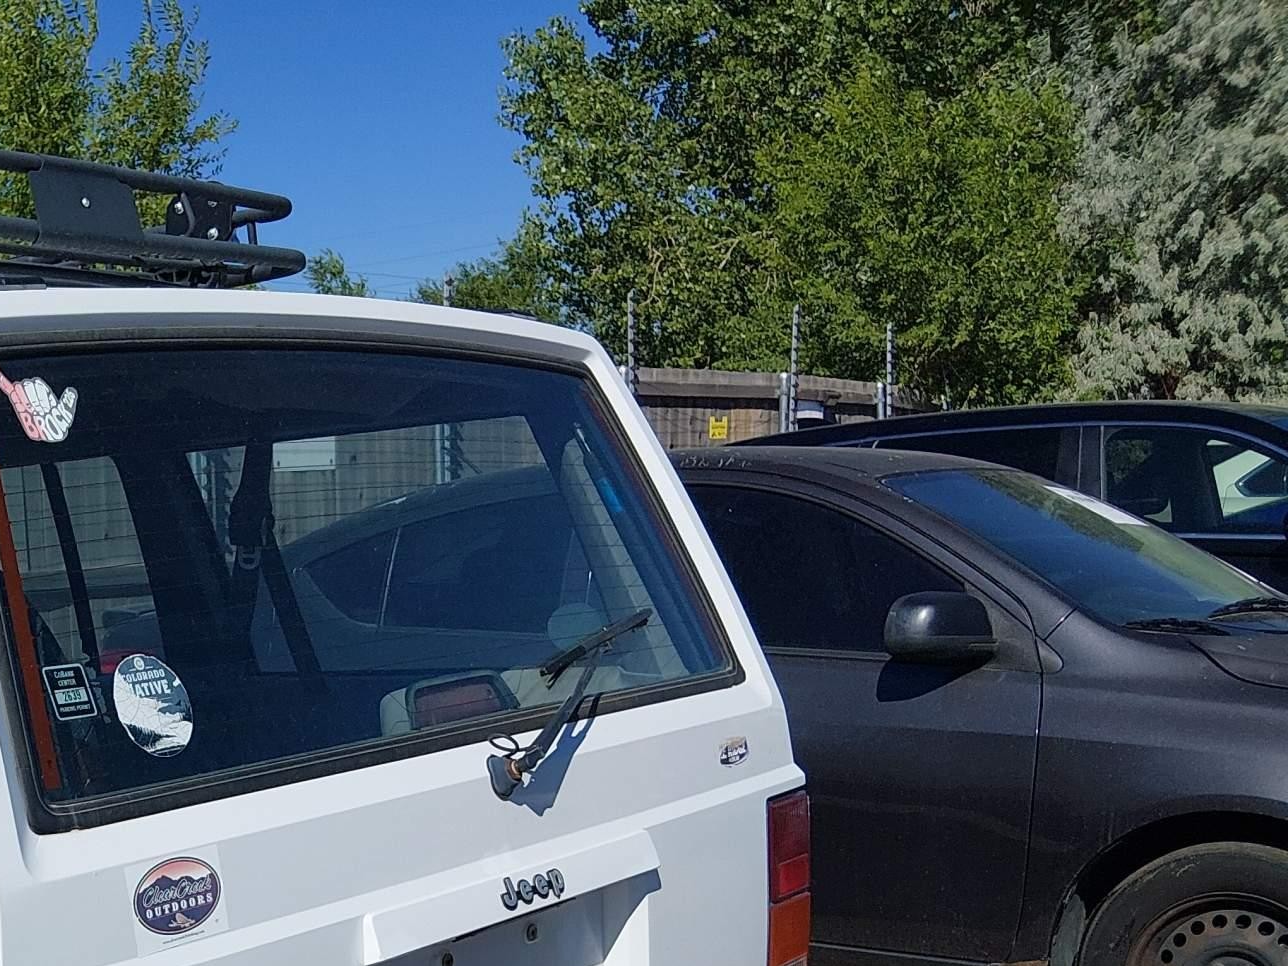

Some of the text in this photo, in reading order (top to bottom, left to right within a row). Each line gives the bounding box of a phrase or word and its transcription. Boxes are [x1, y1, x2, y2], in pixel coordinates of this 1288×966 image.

[62, 689, 82, 702] 2639
[500, 868, 565, 911] Jeep
[145, 892, 213, 919] OUTDOORS
